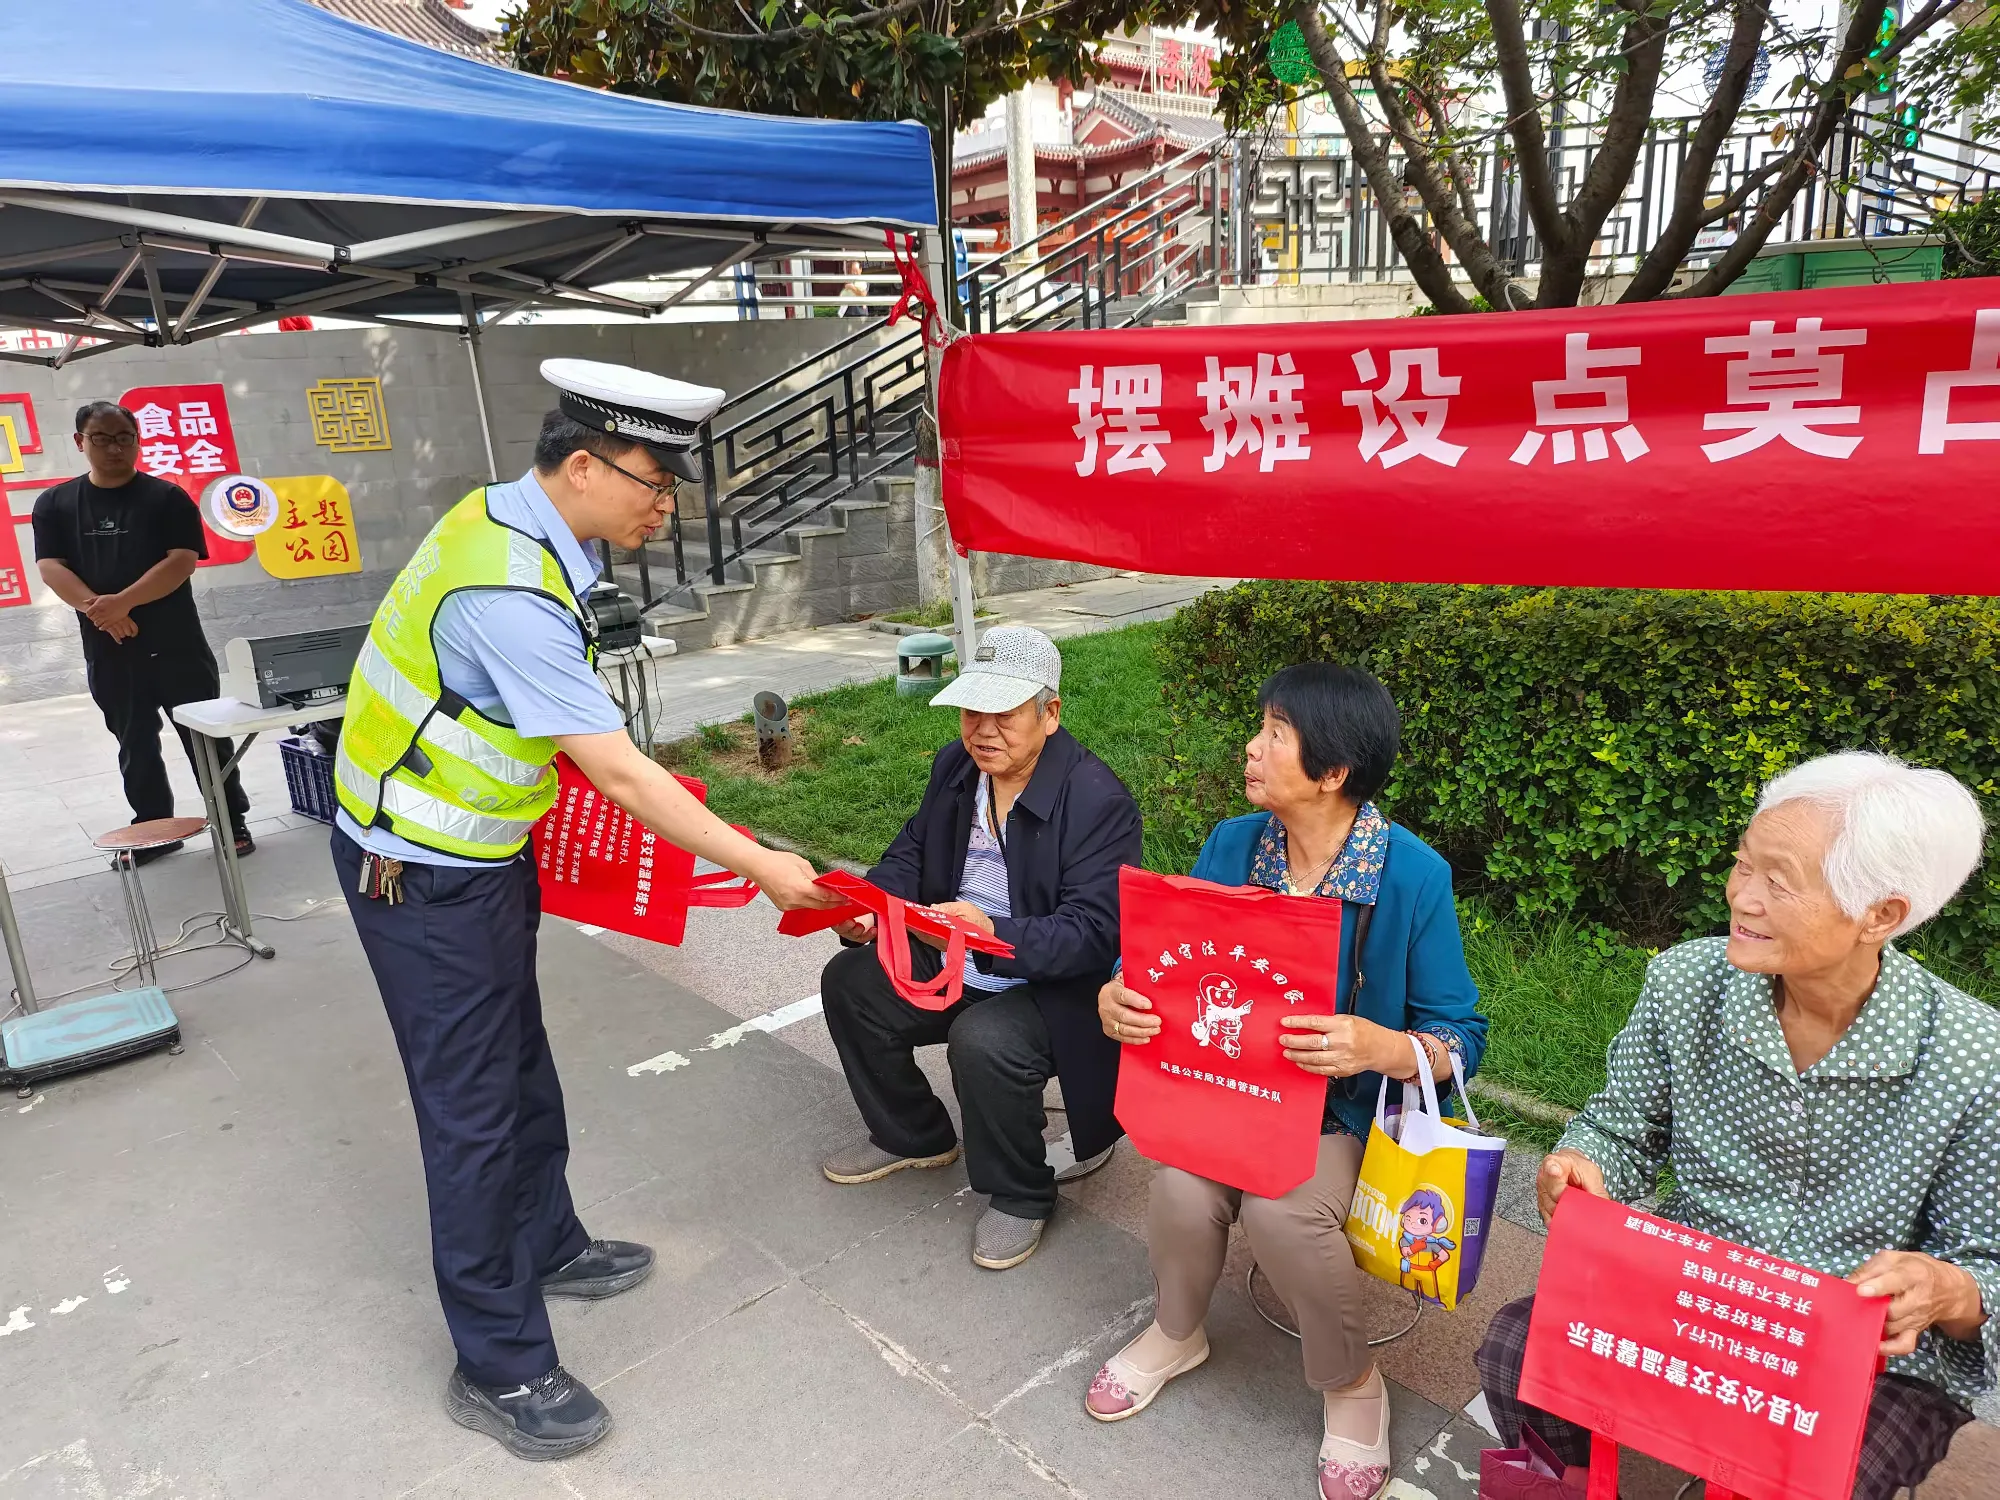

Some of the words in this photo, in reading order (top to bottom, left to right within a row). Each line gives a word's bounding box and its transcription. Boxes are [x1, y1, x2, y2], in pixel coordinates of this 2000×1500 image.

[133, 401, 218, 439] 食品
[141, 439, 227, 477] 安全
[283, 499, 347, 530] 主题
[286, 530, 350, 563] 公园
[633, 826, 656, 917] 安交警温馨提示
[1147, 940, 1217, 983] 文明守法
[1160, 1061, 1283, 1103] 凤县公安局交通管理大队
[1350, 1187, 1400, 1244] BOOM
[1624, 1215, 1713, 1253] 开车不喝酒
[1682, 1259, 1813, 1316] 开车不接打电话
[1725, 1249, 1820, 1288] 喝酒不开车
[1676, 1290, 1807, 1347] 驾车系好安全带
[1671, 1318, 1799, 1378] 机动车礼让行人
[1566, 1321, 1820, 1436] 凤县公安交警温馨提示
